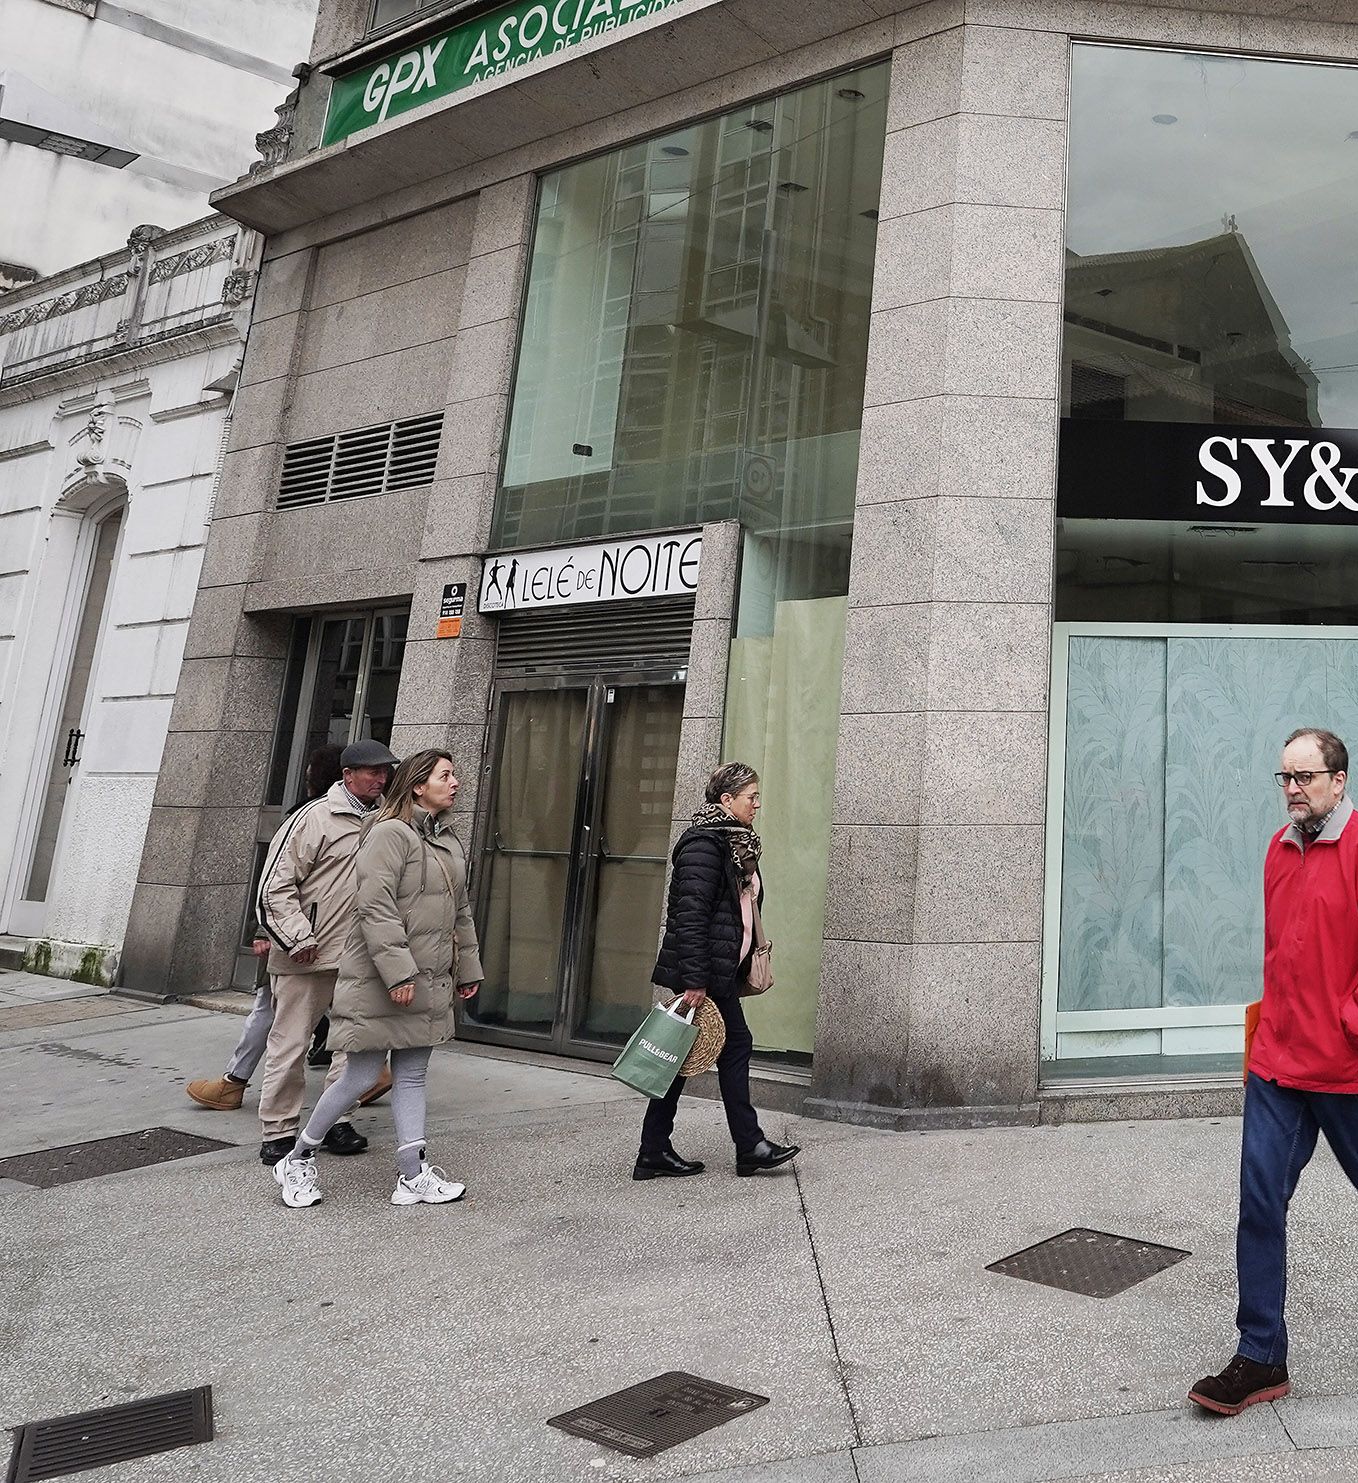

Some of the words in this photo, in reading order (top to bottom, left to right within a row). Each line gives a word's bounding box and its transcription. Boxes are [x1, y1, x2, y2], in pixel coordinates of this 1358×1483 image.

[362, 37, 448, 123] GPX
[463, 0, 644, 75] ASOCIA
[471, 47, 545, 85] AGENCIA
[552, 32, 576, 53] DE
[522, 555, 575, 602] LELÉ
[576, 568, 597, 591] DE
[598, 537, 702, 598] NOITE
[638, 1038, 679, 1064] PULL&BEAR
